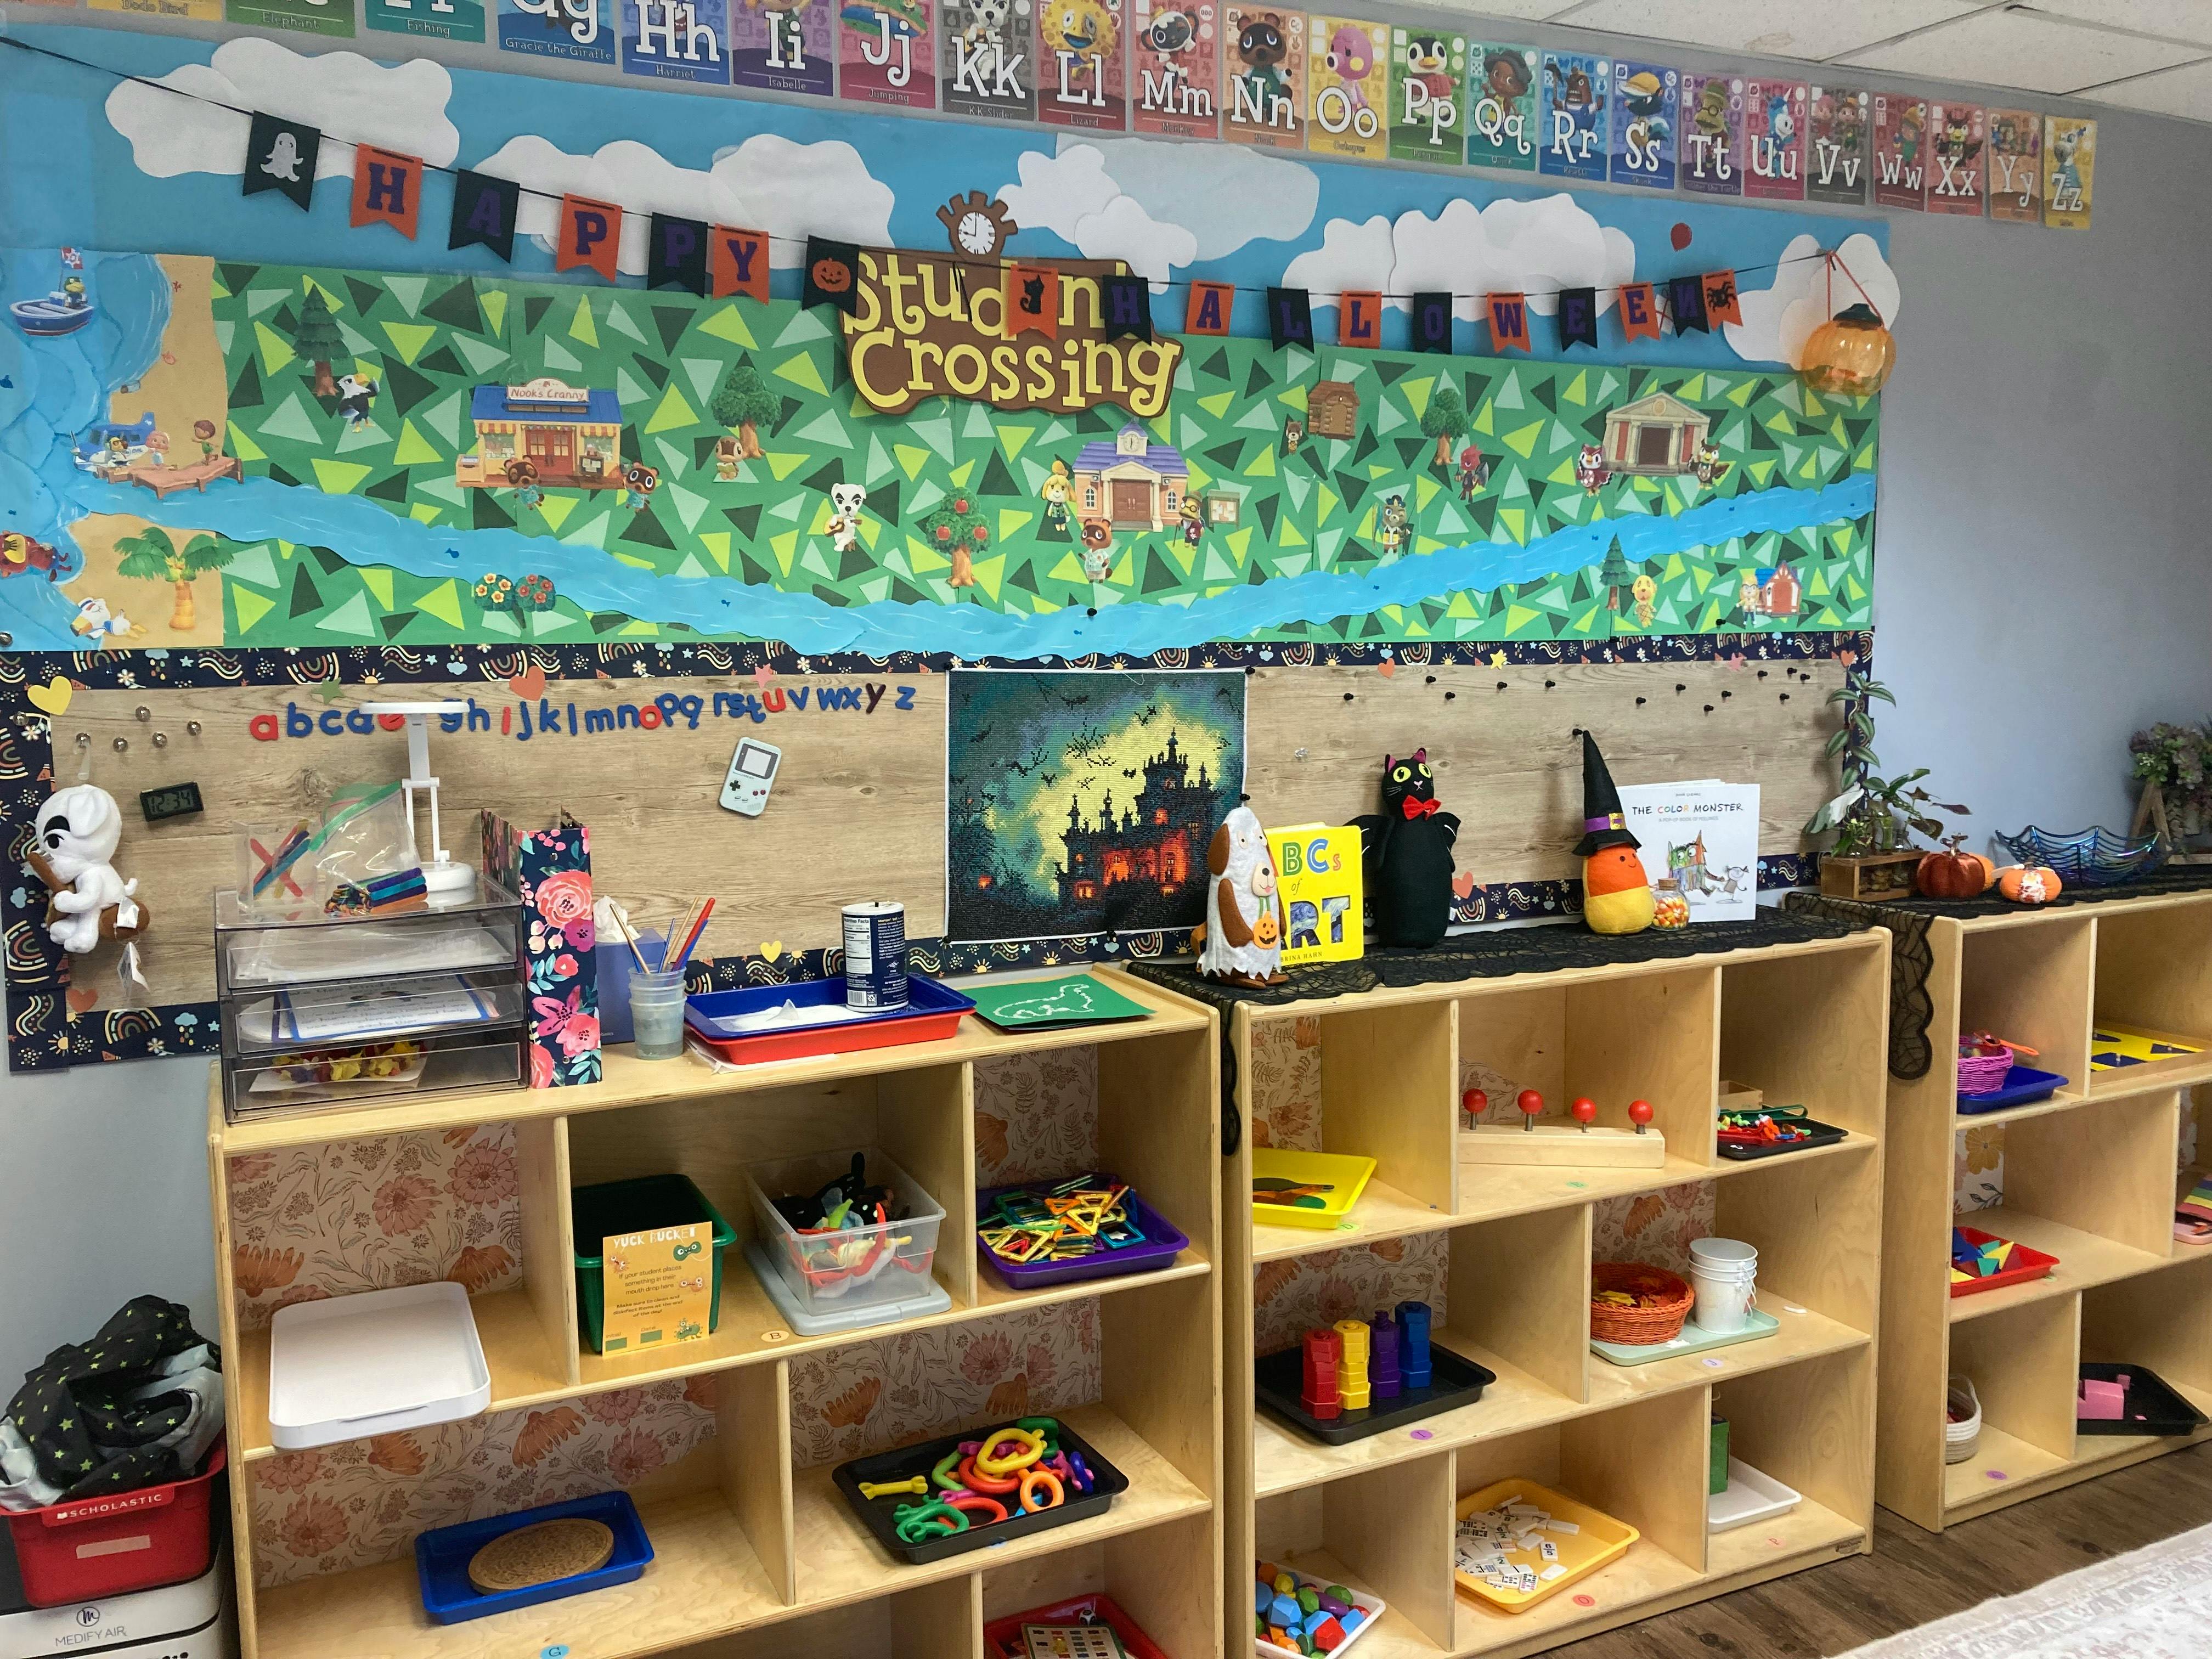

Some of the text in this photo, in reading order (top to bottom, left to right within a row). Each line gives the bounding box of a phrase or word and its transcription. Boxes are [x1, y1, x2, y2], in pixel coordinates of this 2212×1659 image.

[262, 12, 320, 29] Elephant
[407, 19, 450, 38] Fishing
[634, 0, 721, 62] Hh
[764, 11, 806, 70] Ii
[505, 37, 612, 60] Gracie the Giraffe
[860, 12, 911, 87] Jj
[950, 36, 1026, 100] Kk
[656, 65, 696, 79] Harriet
[768, 75, 806, 91] Isabelle
[1056, 49, 1107, 108] Ll
[868, 88, 910, 104] Jumping
[1141, 70, 1214, 117] Mm
[1230, 74, 1296, 131] Nn
[1316, 86, 1379, 139] Oo
[1402, 77, 1458, 146] Pp
[1070, 114, 1099, 127] Lizard
[1474, 98, 1532, 155] Qq
[1551, 109, 1599, 164] Rr
[1625, 121, 1661, 172] Ss
[1688, 134, 1732, 180] Tt
[1751, 134, 1798, 180] Uu
[1815, 144, 1861, 188] Vv
[1878, 151, 1923, 191] Ww
[1934, 156, 1976, 196] Xx
[1997, 155, 2034, 207] Yy
[2052, 173, 2084, 212] Zz
[843, 251, 1140, 341] Studn
[851, 327, 1181, 417] Crossing
[510, 387, 584, 400] Nook's Cranny
[1632, 803, 1743, 815] THE COLOR MONSTER
[1265, 839, 1341, 877] BCs
[1291, 878, 1303, 895] of
[1280, 895, 1351, 951] RT
[613, 1234, 646, 1249] YUCK
[625, 1278, 656, 1287] something
[639, 1268, 662, 1276] student
[70, 1493, 163, 1519] SCHOLASTIC
[55, 1626, 127, 1647] MEDIFY AIR
[549, 1647, 561, 1657] G
